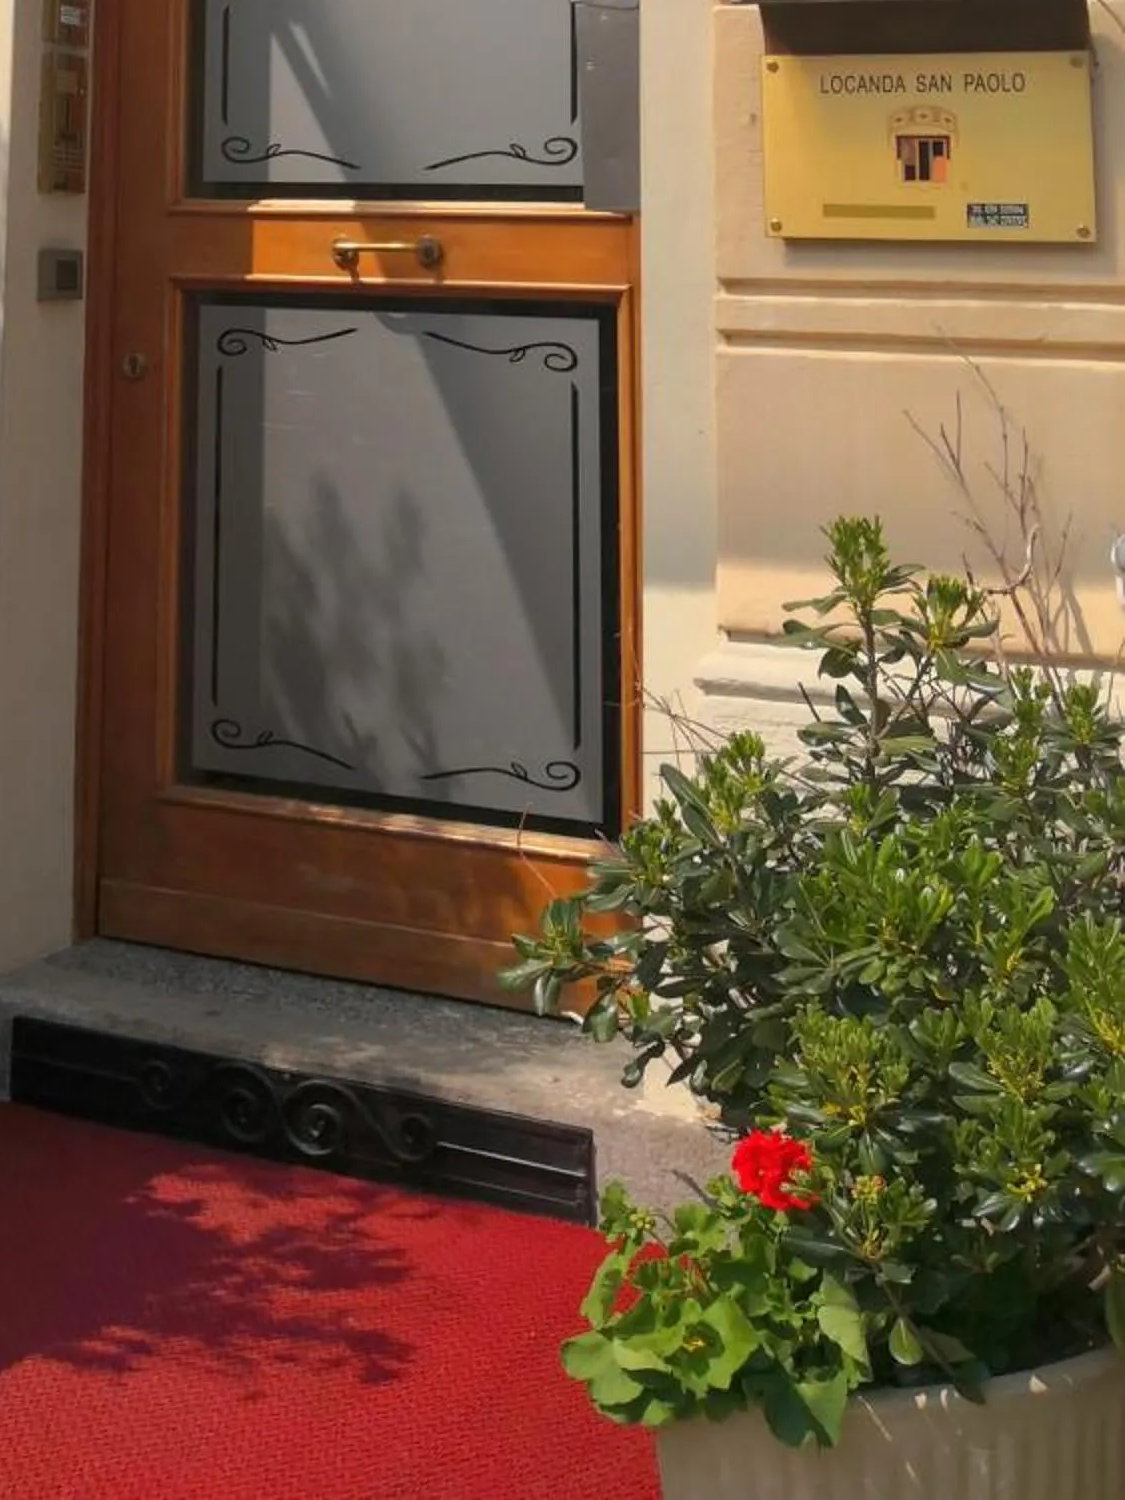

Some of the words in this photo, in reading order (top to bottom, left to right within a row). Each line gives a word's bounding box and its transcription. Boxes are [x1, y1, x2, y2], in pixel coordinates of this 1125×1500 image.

[819, 74, 906, 94] LOCANDA
[915, 74, 952, 93] SAN
[964, 72, 1026, 93] PAOLO
